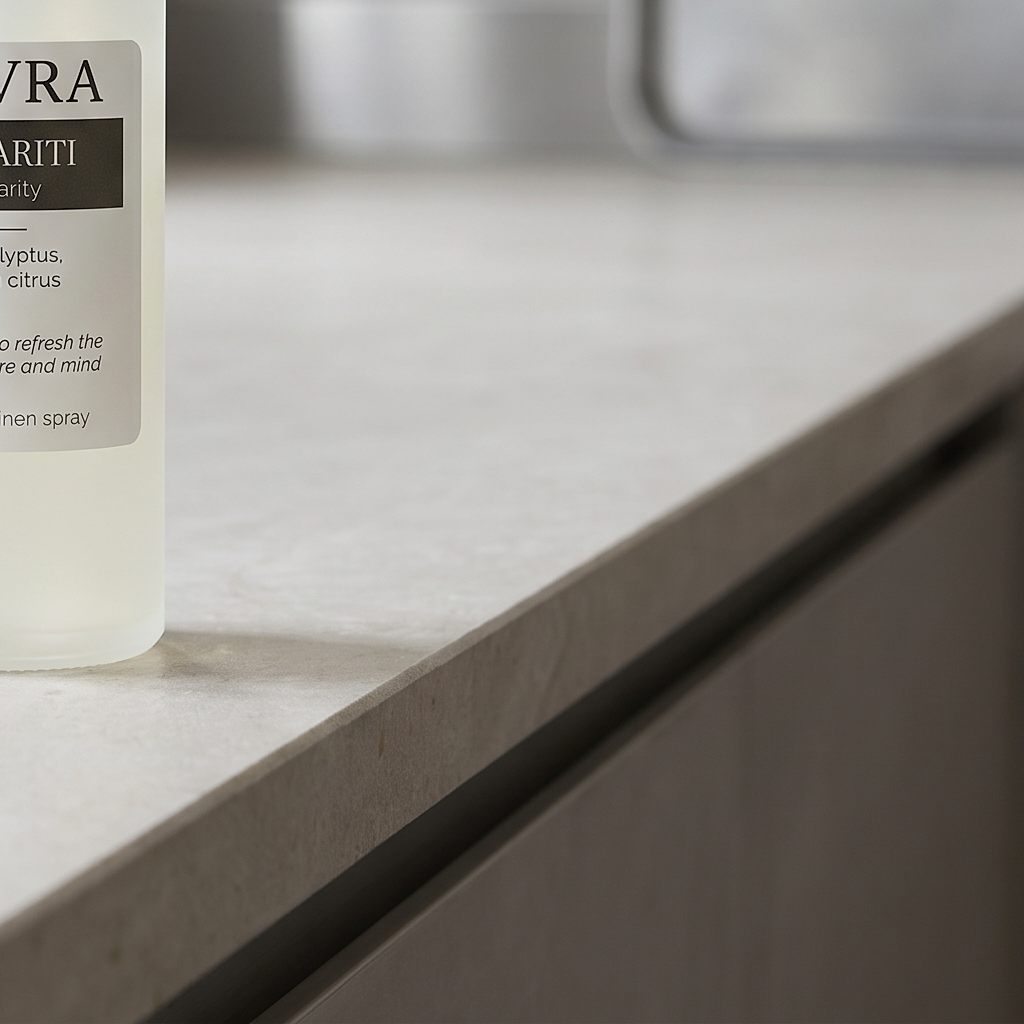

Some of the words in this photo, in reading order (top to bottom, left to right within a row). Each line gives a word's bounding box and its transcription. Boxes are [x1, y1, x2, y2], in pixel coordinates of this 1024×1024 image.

[7, 272, 61, 288] citrus
[14, 334, 74, 355] refresh
[78, 334, 103, 349] the
[21, 357, 56, 374] and
[60, 356, 102, 373] mind
[42, 410, 90, 429] spray
